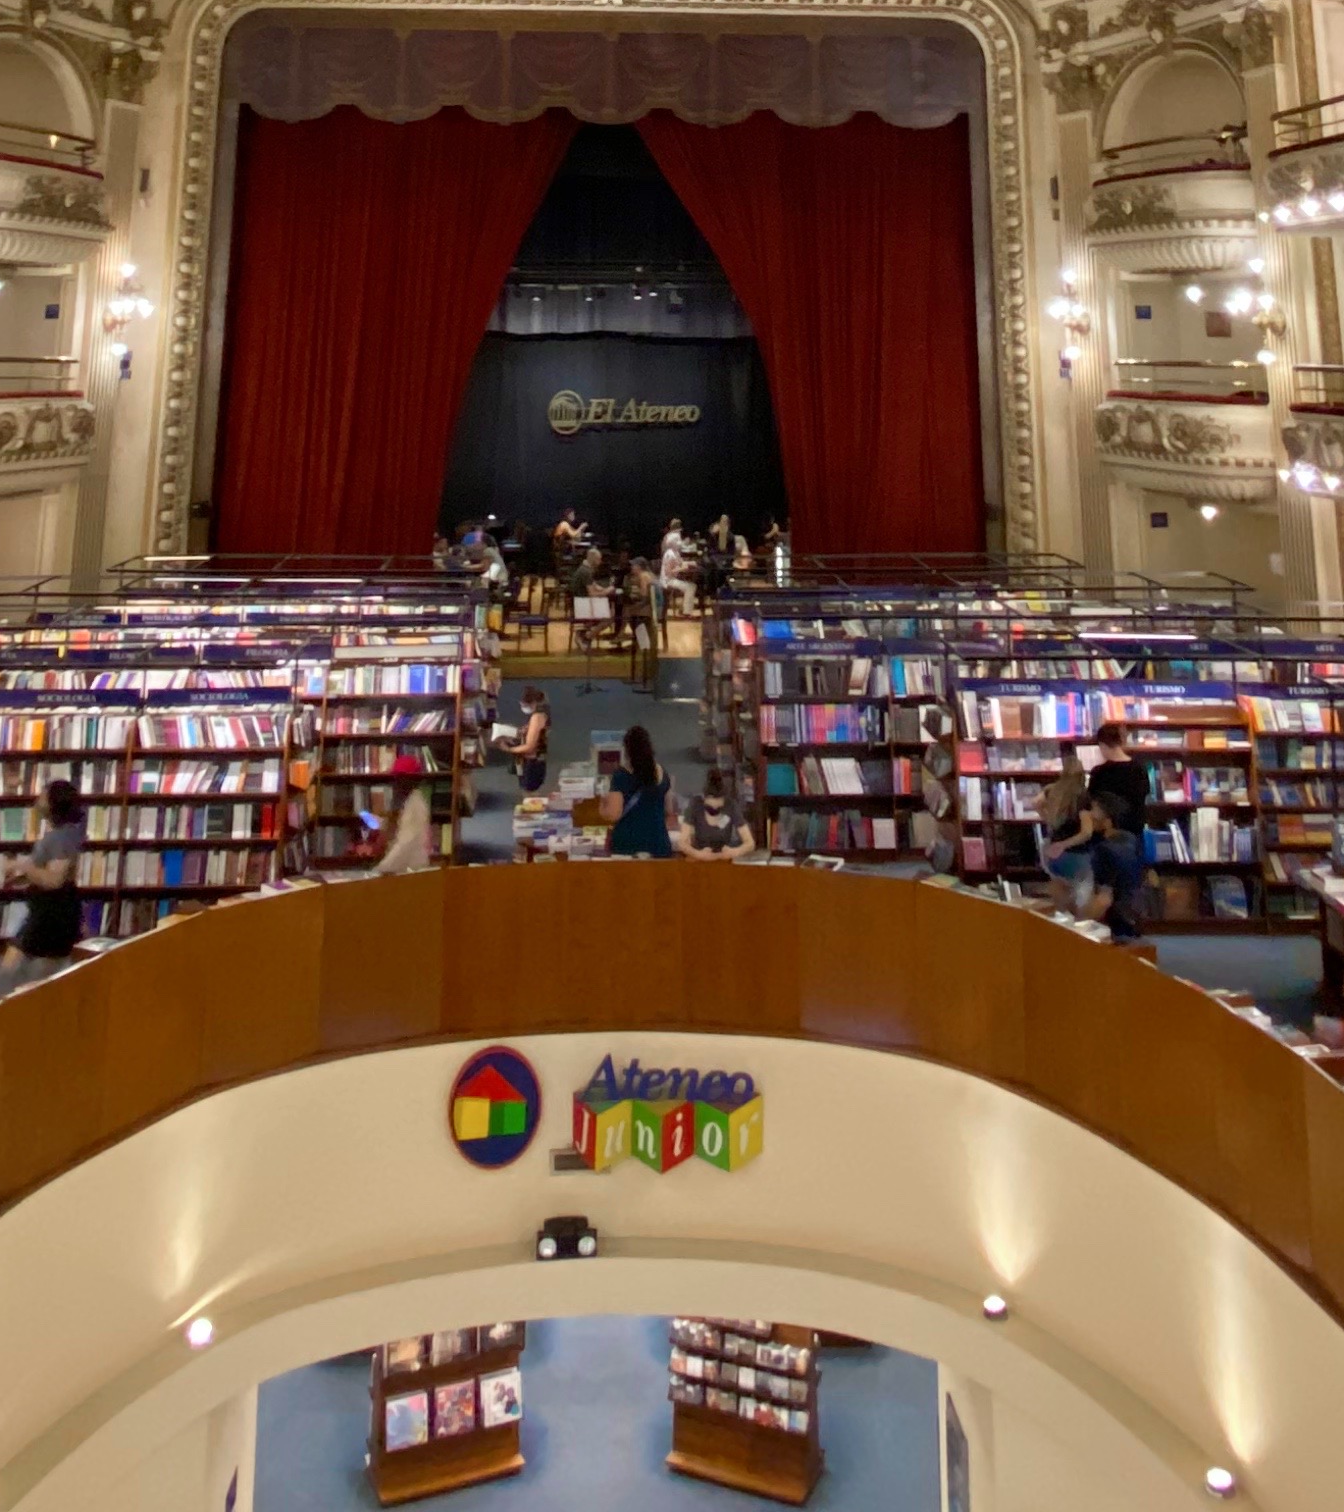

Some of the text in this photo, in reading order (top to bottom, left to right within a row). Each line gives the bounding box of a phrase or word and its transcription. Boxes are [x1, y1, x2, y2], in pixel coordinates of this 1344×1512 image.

[586, 398, 700, 423] El Ateneo
[1000, 685, 1042, 693] TURISMO
[1144, 685, 1186, 694] TURISMO
[585, 1054, 754, 1102] Ateneo
[575, 1108, 760, 1159] Junior
